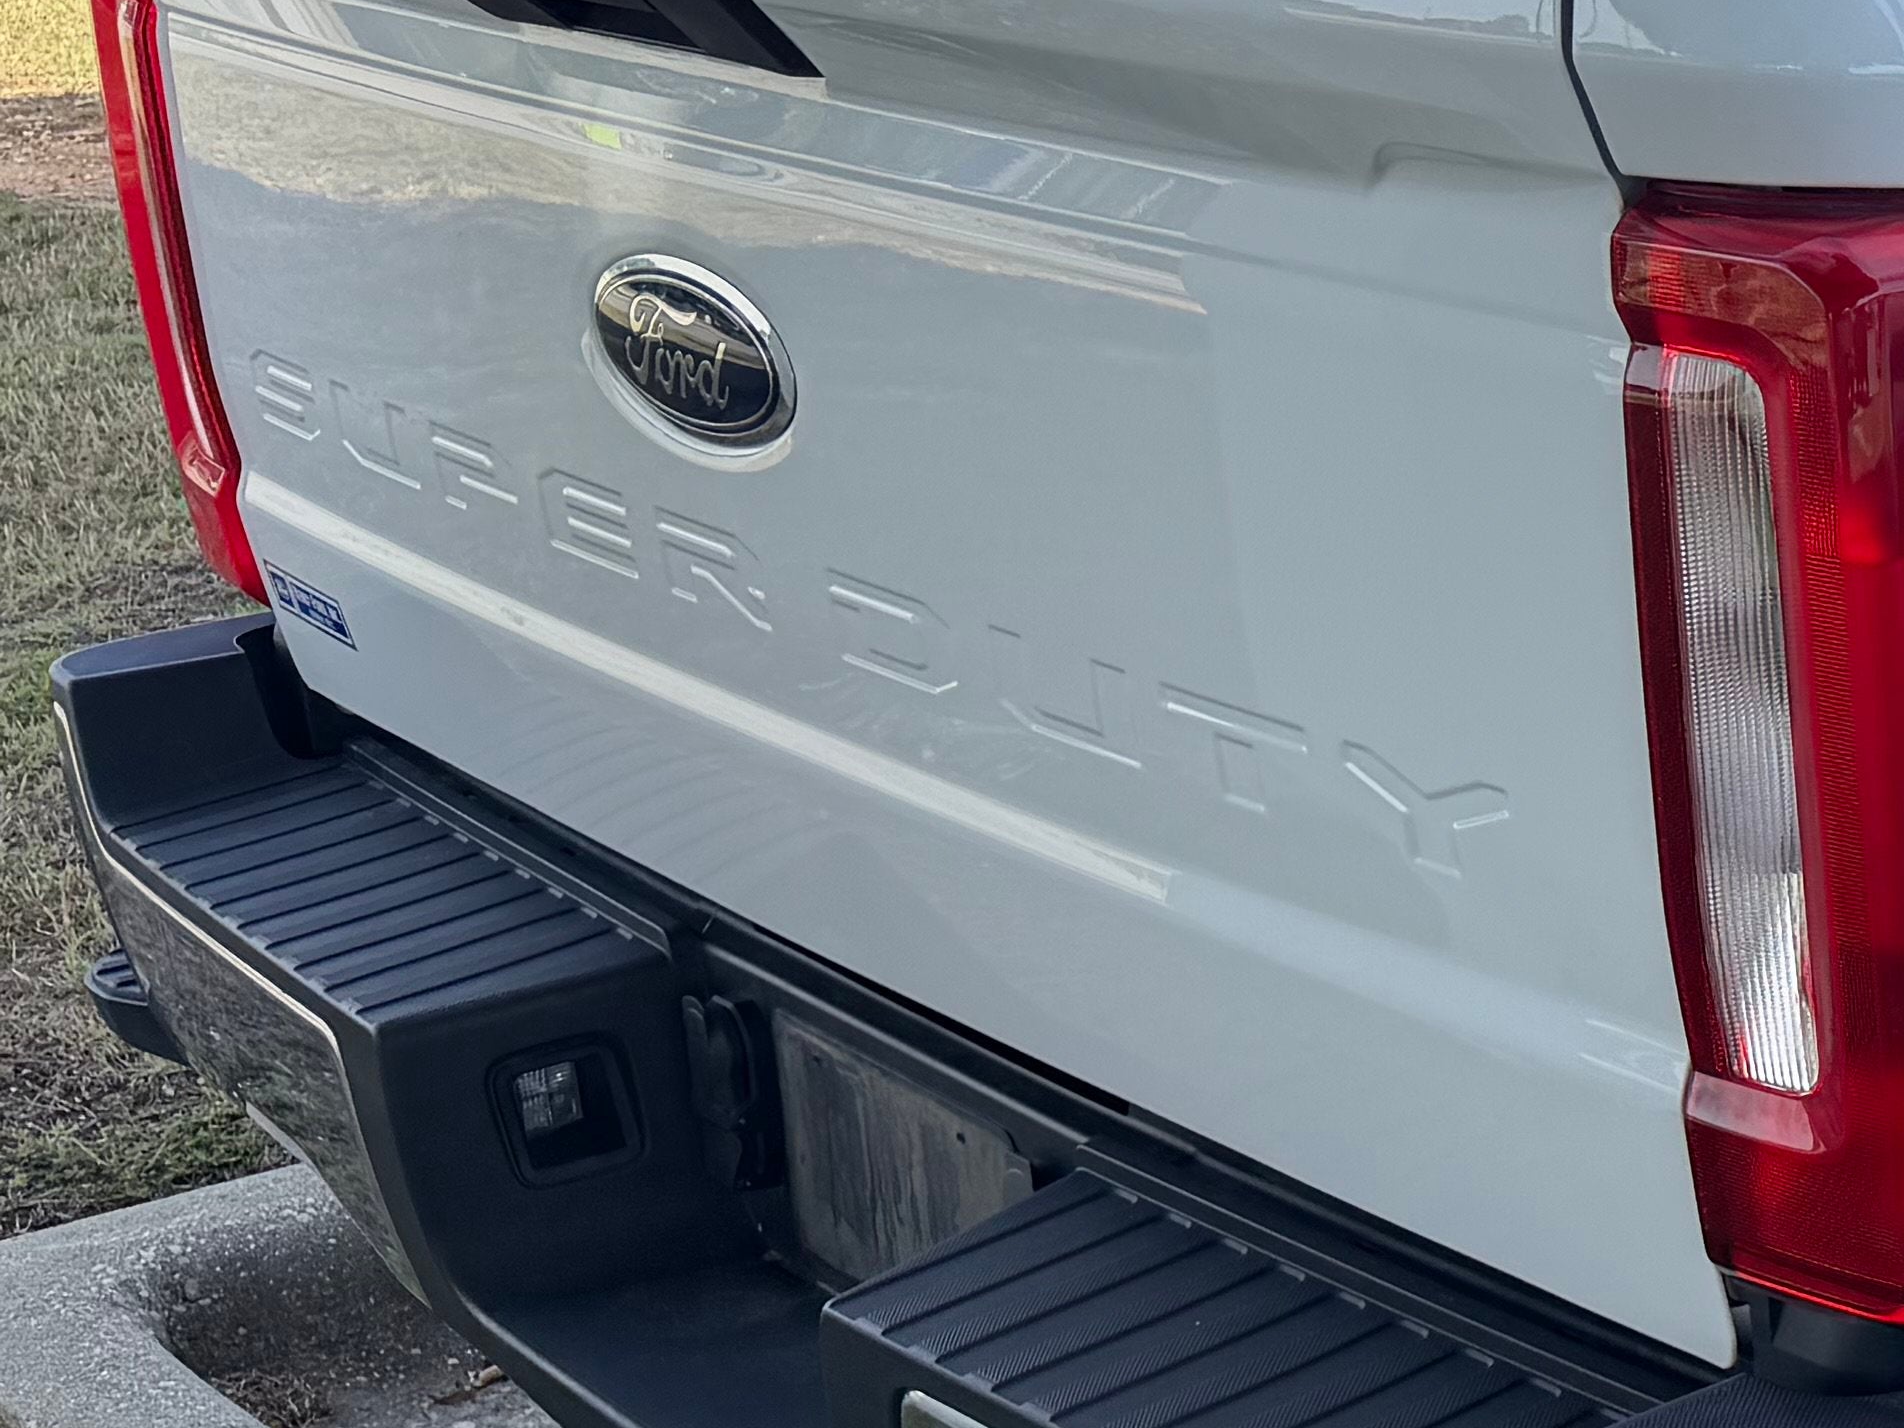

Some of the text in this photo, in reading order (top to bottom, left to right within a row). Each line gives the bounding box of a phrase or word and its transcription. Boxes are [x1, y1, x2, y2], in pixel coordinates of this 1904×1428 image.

[625, 293, 730, 410] Ford
[249, 347, 1512, 879] SUPER DUTY
